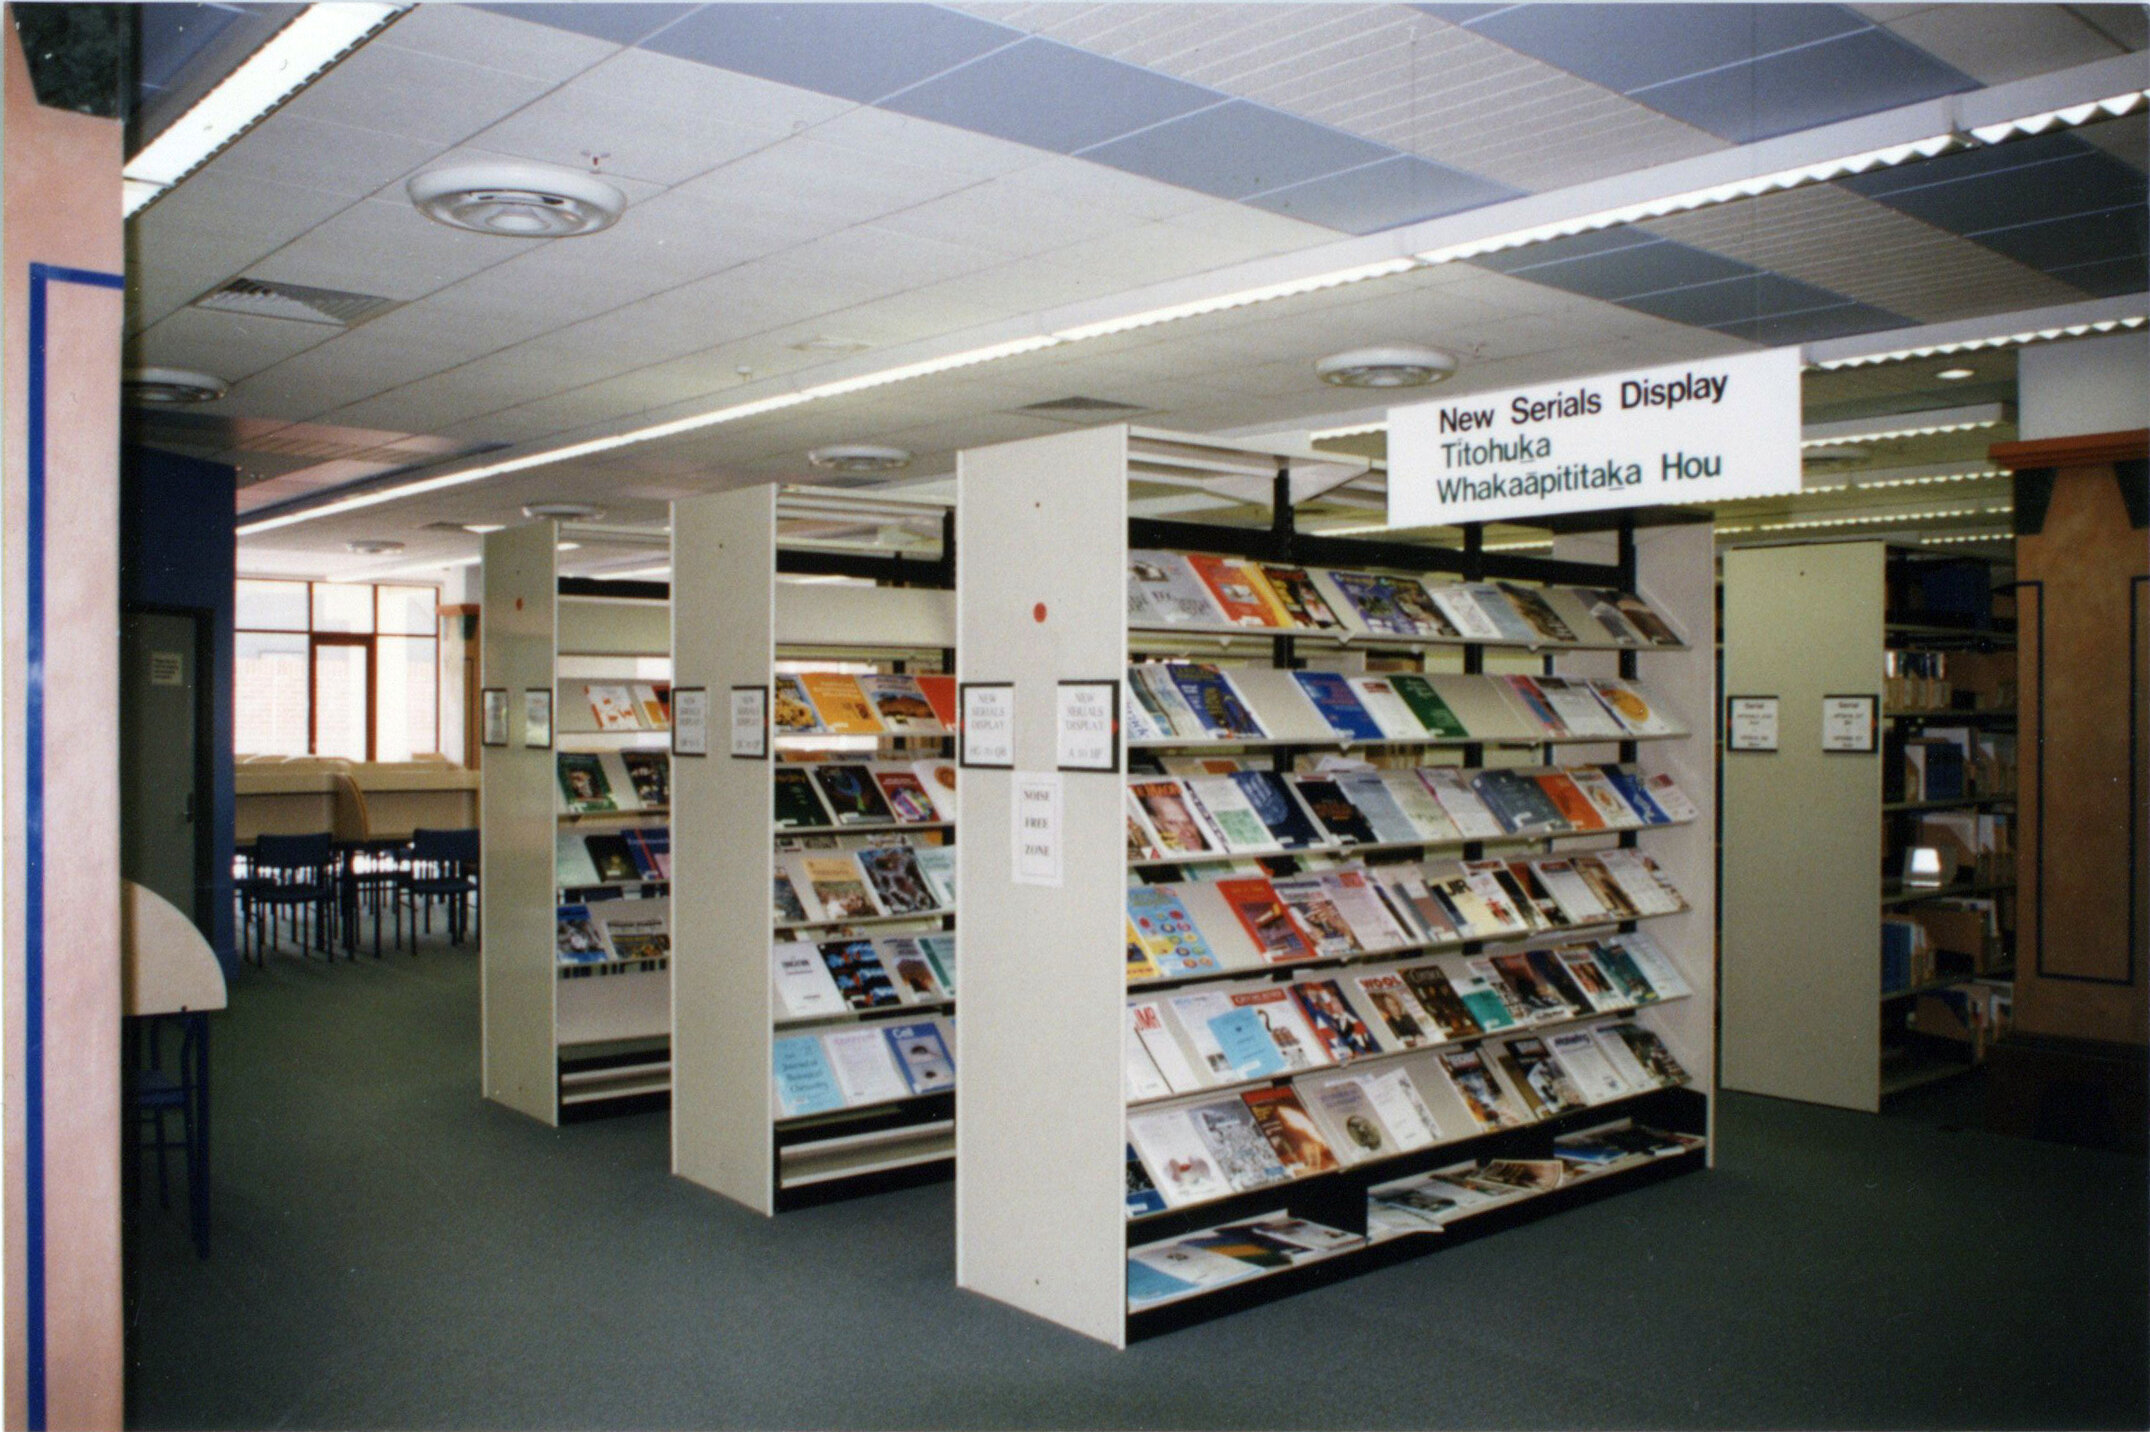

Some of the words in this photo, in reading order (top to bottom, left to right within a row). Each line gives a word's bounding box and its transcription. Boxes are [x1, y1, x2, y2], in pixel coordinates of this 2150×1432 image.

[1439, 407, 1495, 434] New
[1511, 388, 1602, 425] Serials
[1621, 372, 1728, 410] Display
[1662, 451, 1721, 481] Hou
